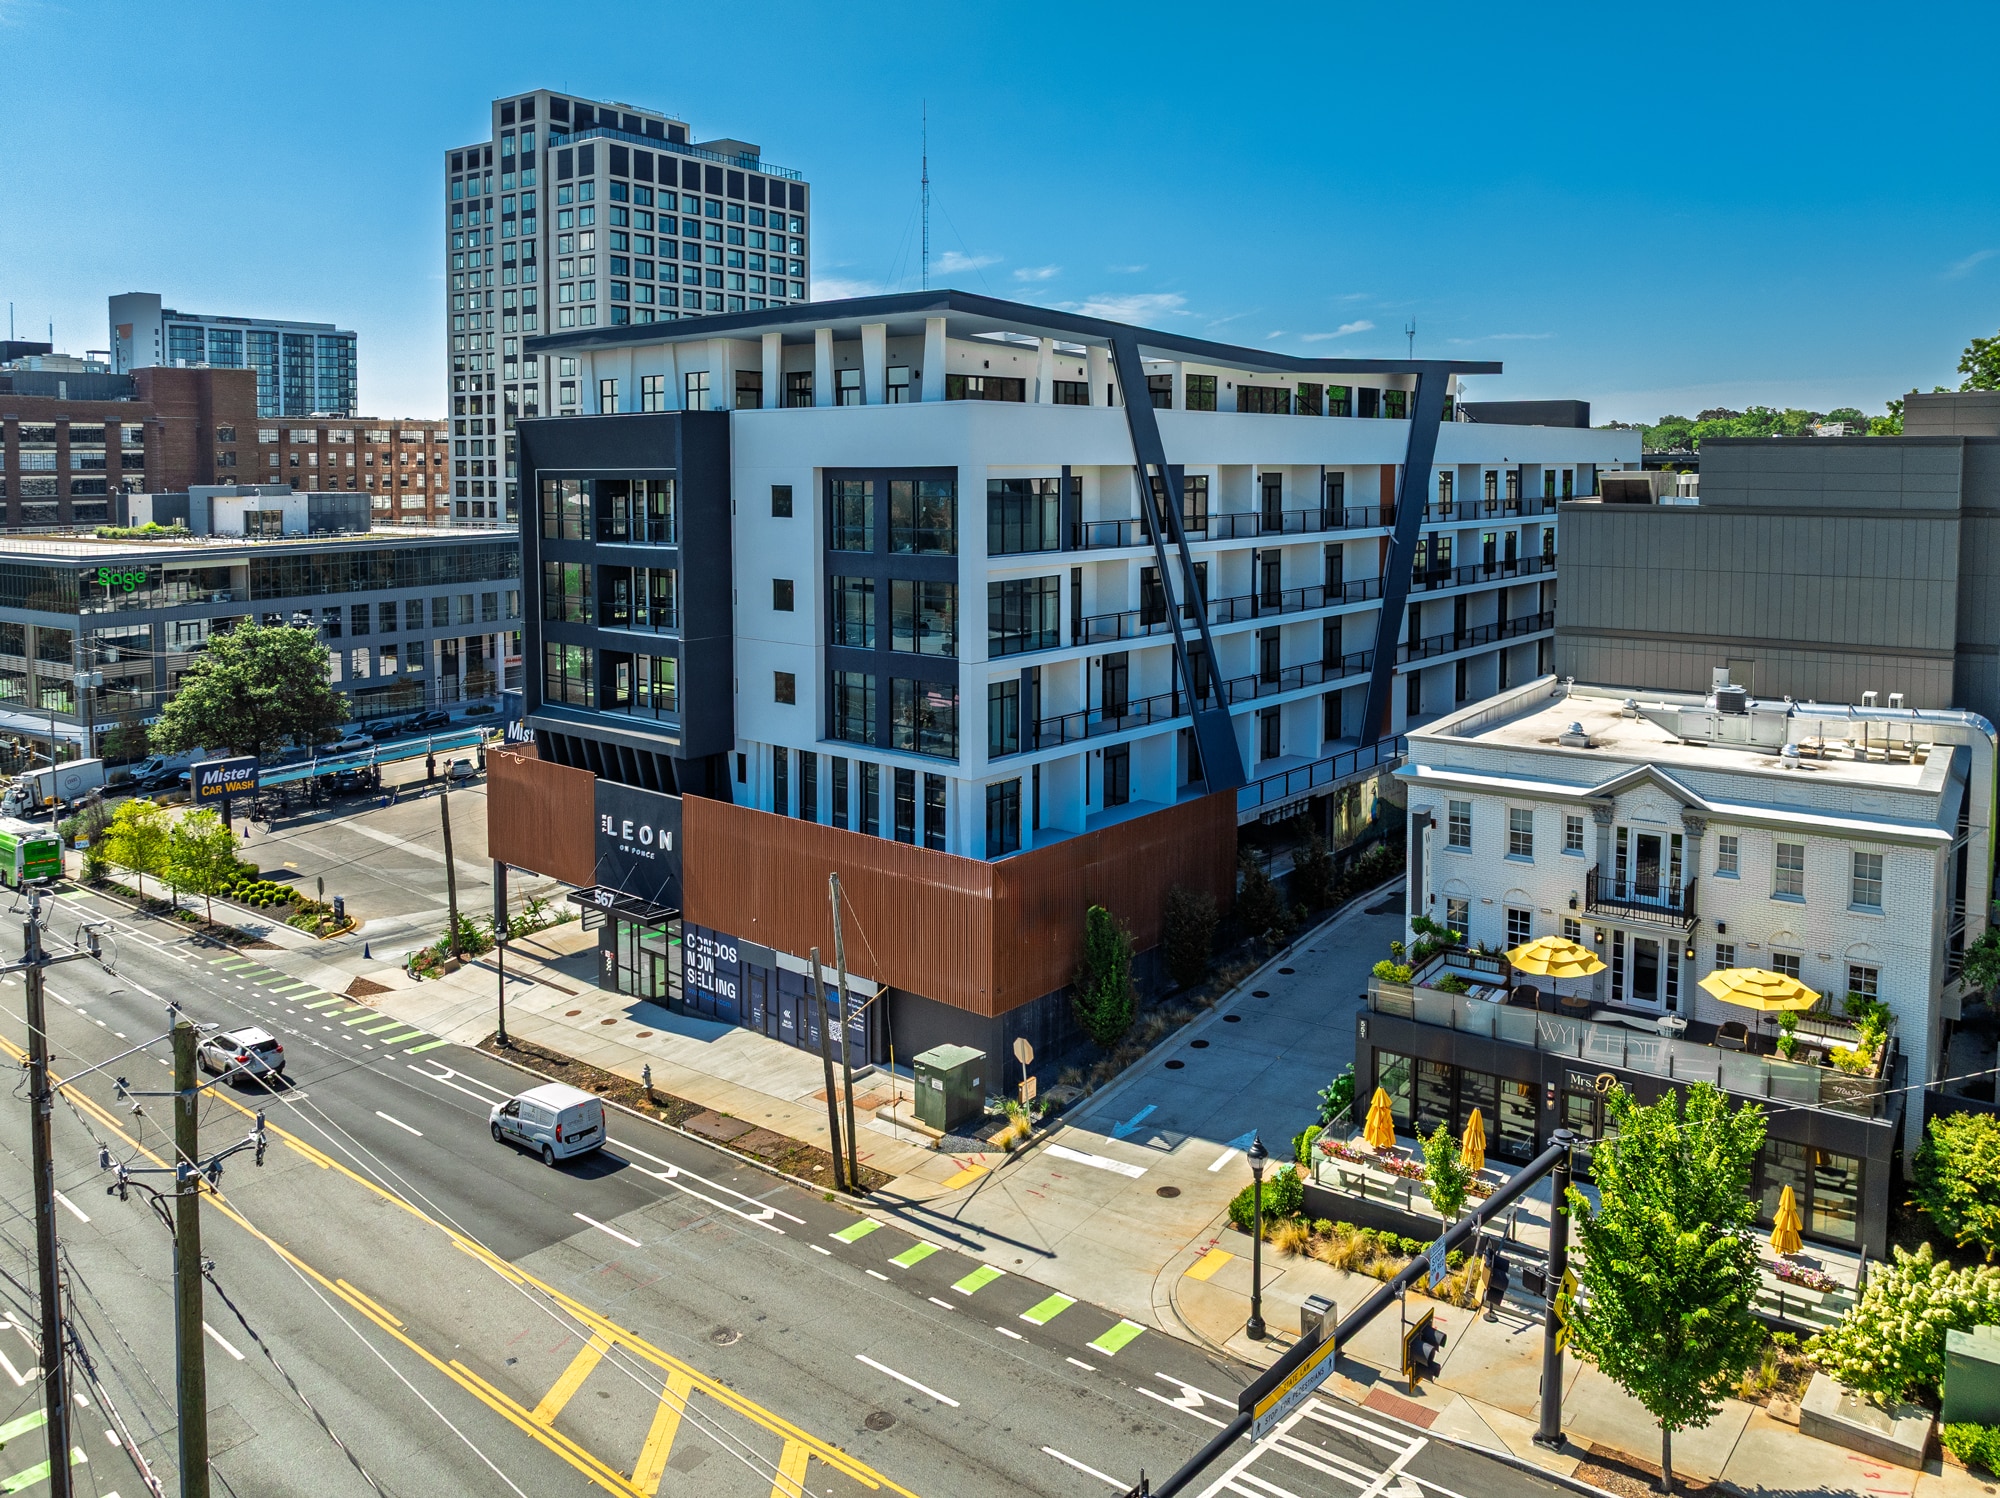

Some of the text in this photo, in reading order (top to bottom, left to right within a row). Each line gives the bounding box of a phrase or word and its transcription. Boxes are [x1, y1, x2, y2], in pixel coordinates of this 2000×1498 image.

[97, 567, 147, 592] Sage
[202, 766, 254, 785] Mister
[201, 779, 255, 797] CAR WASH
[606, 815, 673, 852] LEON
[619, 844, 656, 860] ON PONCE
[594, 889, 615, 908] 567
[686, 933, 738, 964] CONDOS
[687, 950, 715, 974] NOW
[687, 968, 736, 999] SELLING
[1570, 1073, 1594, 1088] Mrs.
[1283, 1361, 1311, 1392] STATE LAW
[1265, 1366, 1325, 1425] STOP FOR PEDESTRIANS
